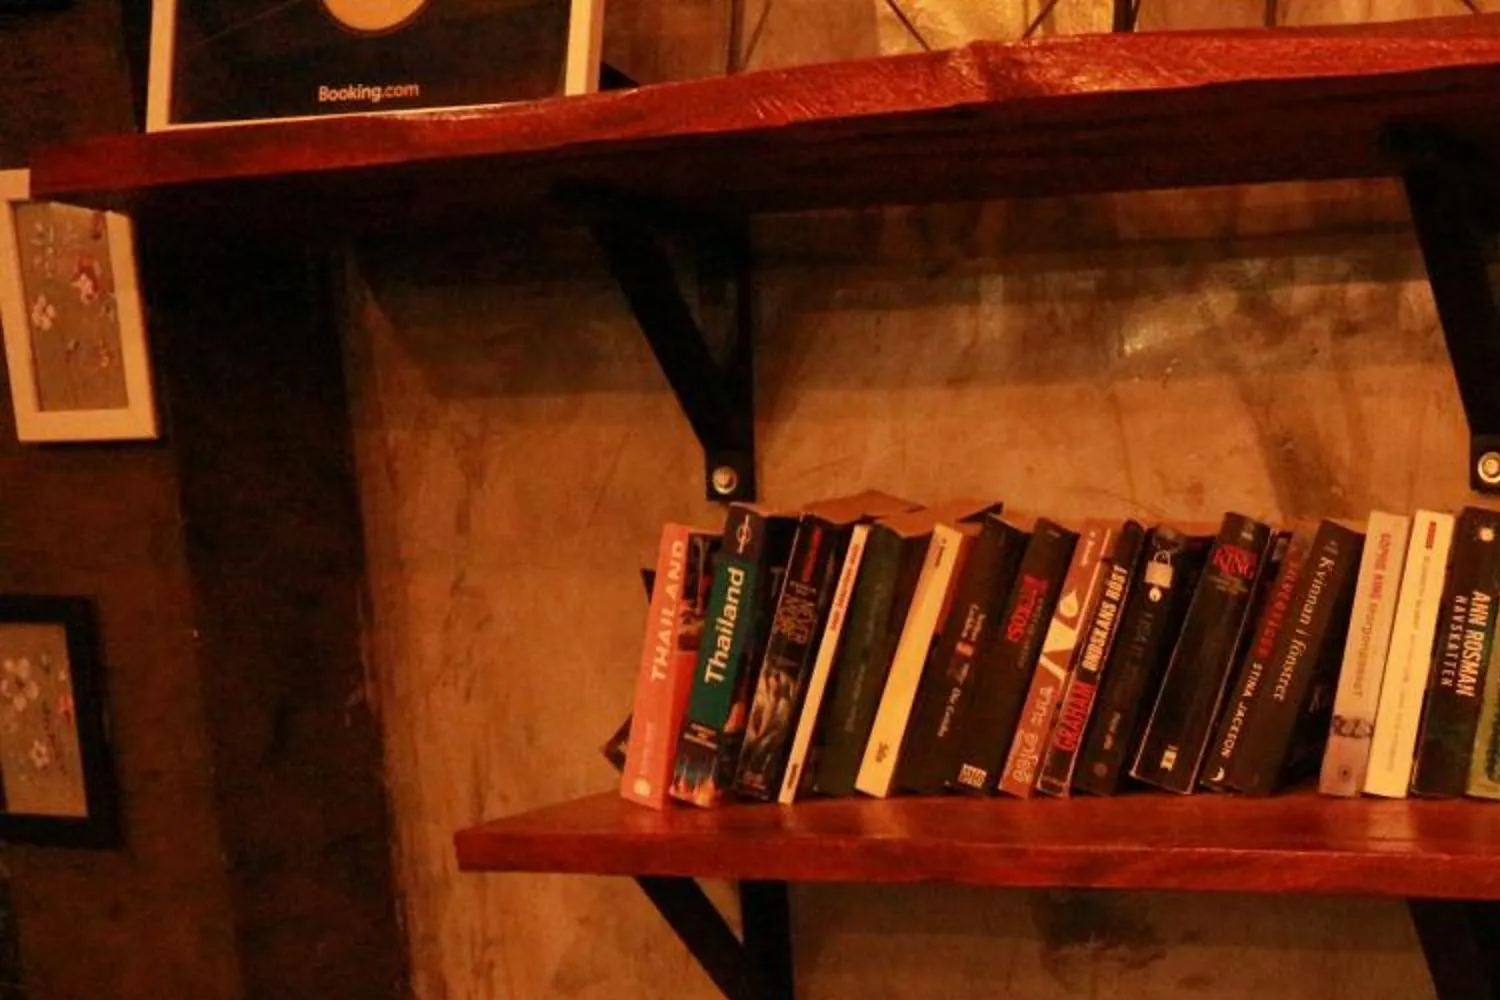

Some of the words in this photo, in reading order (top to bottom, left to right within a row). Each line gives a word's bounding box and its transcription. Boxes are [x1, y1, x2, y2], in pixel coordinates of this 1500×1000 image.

[318, 84, 419, 103] Booking.com
[651, 540, 684, 680] THAILAND
[705, 567, 744, 682] Thailand
[1300, 556, 1335, 625] Kvinnan
[1468, 591, 1491, 627] ANN
[1242, 662, 1263, 697] STINA
[1457, 629, 1485, 697] ROSMAN
